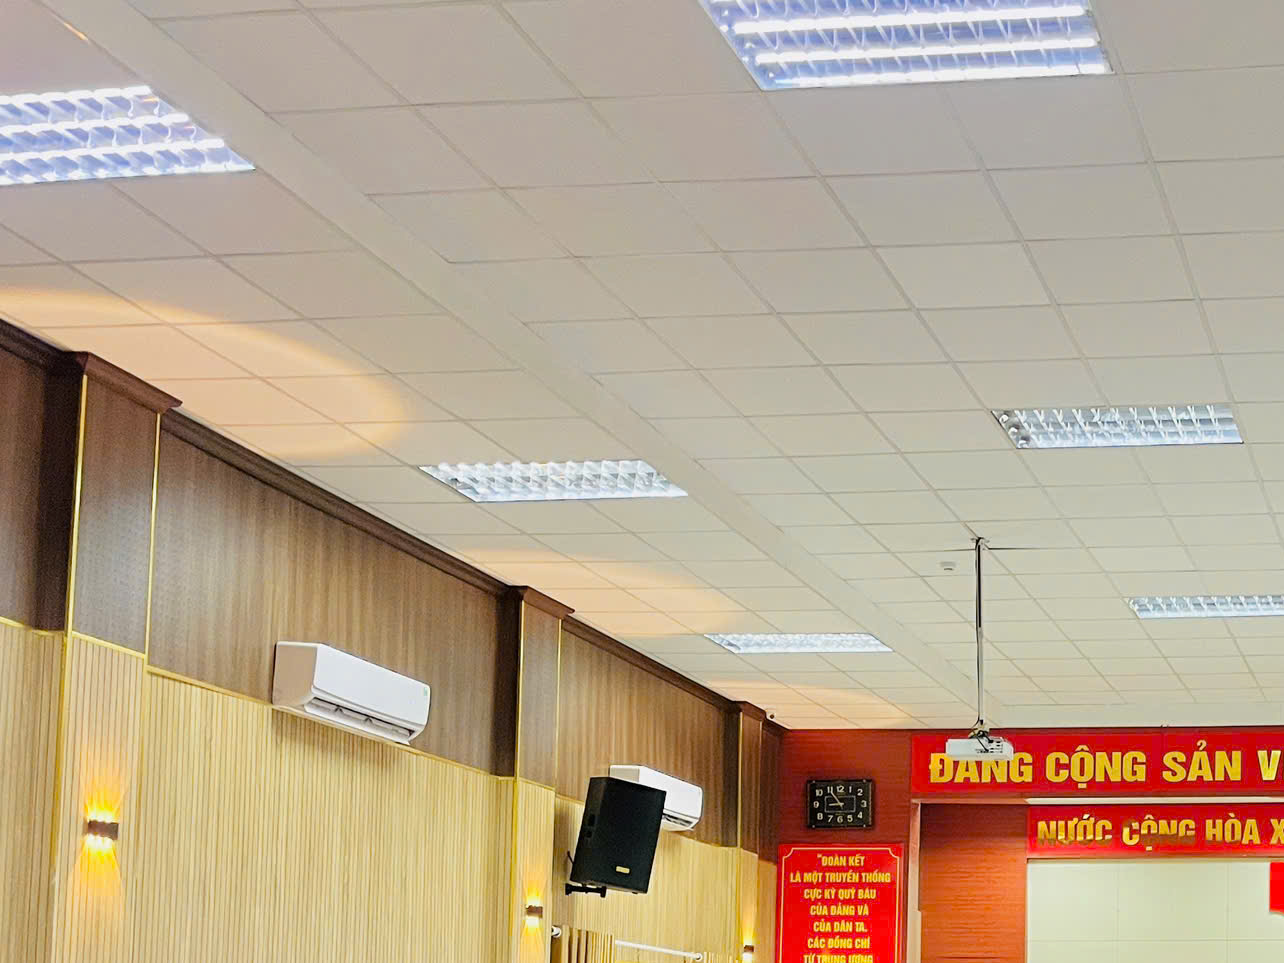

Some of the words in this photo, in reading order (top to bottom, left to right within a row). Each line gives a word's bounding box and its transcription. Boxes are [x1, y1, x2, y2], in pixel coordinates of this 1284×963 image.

[1046, 745, 1146, 788] CỘNG
[1162, 740, 1242, 783] SẢN
[836, 785, 844, 793] 12
[1037, 814, 1113, 845] NƯỚC
[1122, 815, 1196, 851] CỘNG
[1205, 813, 1260, 844] HÒA
[849, 854, 865, 866] KẾT
[807, 936, 826, 949] CÁC
